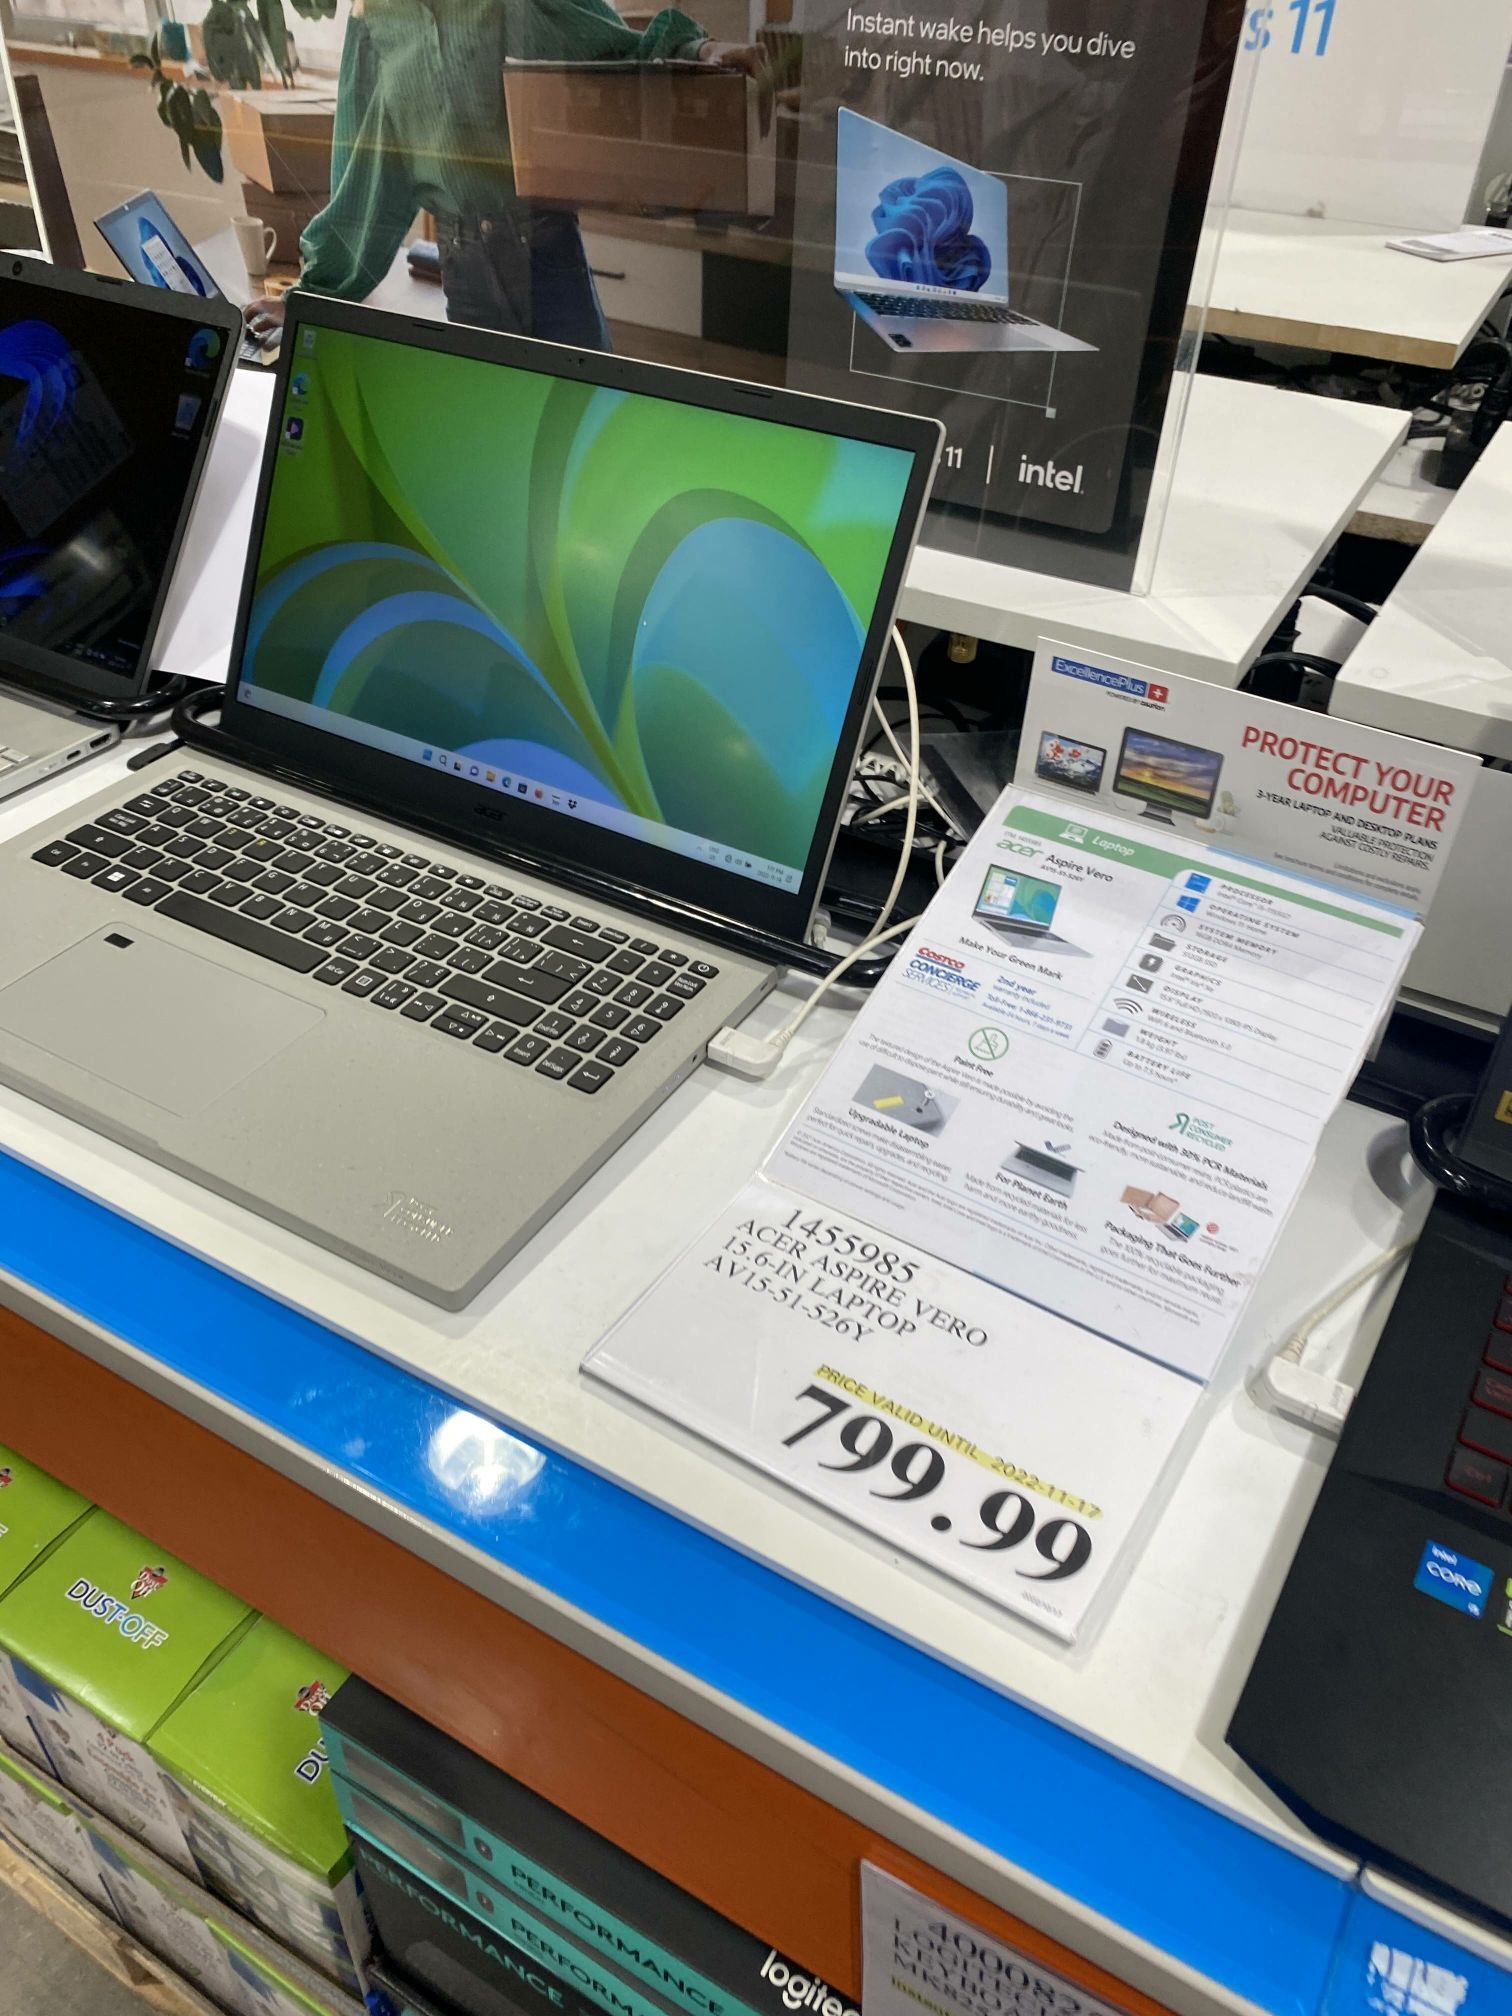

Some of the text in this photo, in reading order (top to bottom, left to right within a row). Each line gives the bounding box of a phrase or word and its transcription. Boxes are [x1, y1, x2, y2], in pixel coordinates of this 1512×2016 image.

[846, 8, 1136, 59] Instant wake helps you dive
[1288, 0, 1338, 56] 11
[844, 47, 985, 82] into right now.
[945, 446, 963, 469] 11
[1054, 658, 1146, 695] ExcellencePlus
[1239, 725, 1459, 805] PROTECT YOUR
[1255, 789, 1439, 850] 3-YEAR LAPTOP AND DESKTOP PLANS
[1284, 766, 1449, 832] COMPUTER
[995, 837, 1043, 860] acer
[1043, 853, 1115, 883] Aspire Vero
[1089, 835, 1137, 858] Laptop
[1319, 831, 1357, 848] AGAINST
[1357, 842, 1390, 858] COSTLY
[1330, 825, 1435, 862] VALUABLE PROTECTION
[901, 967, 952, 993] SERVICES
[907, 958, 981, 992] CONCIERGE
[957, 936, 1065, 980] Make Your Green Mark
[995, 975, 1036, 997] 2nd year
[952, 1055, 995, 1078] Paint Free
[846, 1107, 899, 1136] Upgradable
[896, 1129, 931, 1150] Laptop
[1111, 1120, 1158, 1146] Designed
[1156, 1139, 1180, 1153] with
[1222, 1165, 1270, 1191] Materials
[994, 1171, 1070, 1210] For Planet Earth
[782, 1209, 920, 1284] 1455985
[1102, 1220, 1155, 1250] Packaging
[1153, 1242, 1178, 1259] That
[1177, 1252, 1203, 1270] Goes
[1202, 1264, 1242, 1288] Further
[704, 1255, 874, 1343] AV15-51-526Y
[723, 1236, 916, 1337] 15.6-IN LAPTOP
[737, 1219, 988, 1348] ACER ASPIRE VERO
[816, 1364, 1101, 1519] PRICE VALID UNTIL 2022-11-17
[781, 1384, 1092, 1580] 799.99
[360, 1847, 565, 2007] PERFORMANCE
[511, 1865, 724, 2014] PERFORMANCE
[511, 1918, 645, 2016] PERFORM
